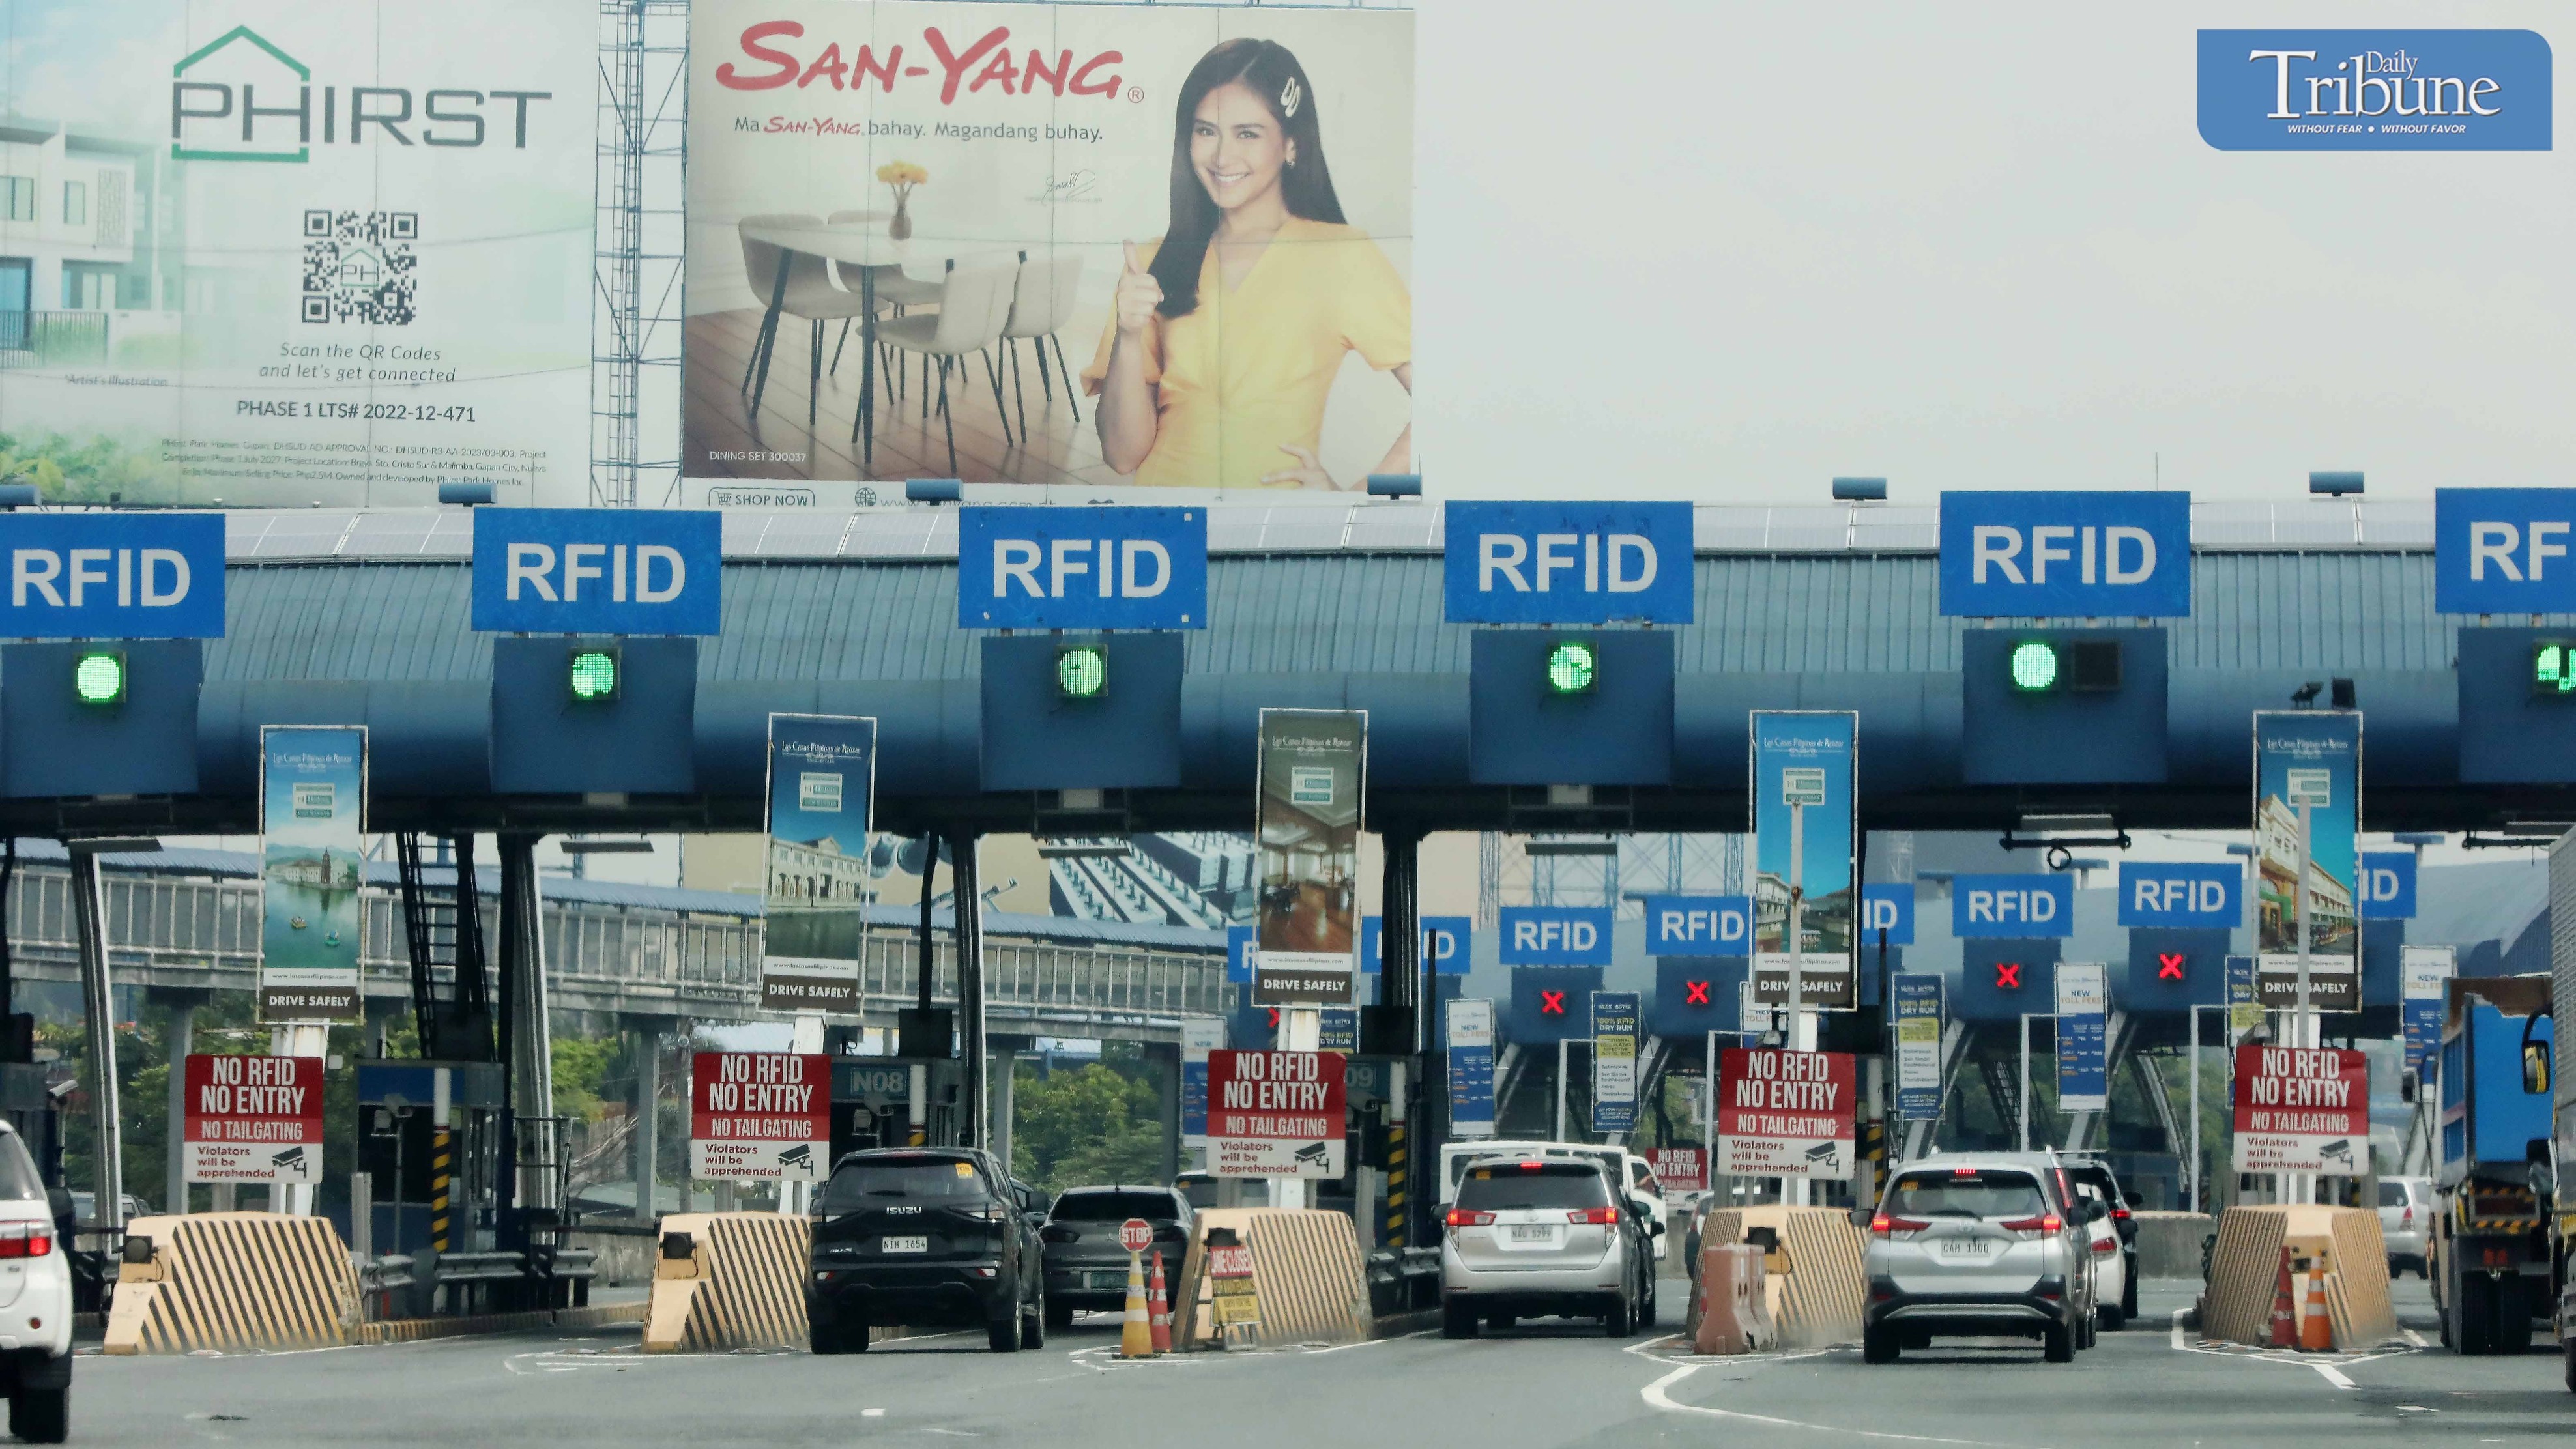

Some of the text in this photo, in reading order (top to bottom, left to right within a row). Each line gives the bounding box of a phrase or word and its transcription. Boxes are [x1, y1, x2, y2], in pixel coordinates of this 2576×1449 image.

[716, 20, 1123, 104] SAN-YANG
[172, 83, 552, 149] PHIRST
[735, 117, 1102, 142] Ma SAN-YANG bahay. Magandang buhay.
[280, 342, 441, 361] Scan the QR Codes
[259, 364, 456, 382] and let's get connected
[237, 400, 476, 422] PHASE 1 LTS# 2022-12-471
[710, 451, 807, 462] DINING SET 300037
[383, 474, 424, 483] developed
[425, 475, 435, 484] by
[736, 494, 808, 506] SHOP NOW
[1972, 525, 2156, 585] RFID
[2470, 521, 2571, 582] RF
[506, 543, 686, 603] RFID
[992, 539, 1171, 598] RFID
[1478, 534, 1658, 593] RFID
[12, 549, 191, 607] RFID
[2134, 880, 2225, 912] RFID
[1863, 900, 1898, 929] ID
[1968, 890, 2056, 923] RFID
[1514, 921, 1597, 951] RFID
[1662, 911, 1744, 941] RFID
[770, 984, 850, 998] DRIVE SAFELY
[1264, 979, 1345, 991] DRIVE SAFELY
[1761, 980, 1843, 992] DRIV SAFELY
[269, 996, 350, 1006] DRIVE SAFELY
[213, 1057, 295, 1085] NO RFID
[721, 1055, 802, 1083] NO RFID
[1236, 1052, 1318, 1081] NO RFID
[1748, 1052, 1829, 1081] NO RFID
[2263, 1049, 2339, 1079] NO RFID
[853, 1070, 904, 1093] N08
[1346, 1067, 1373, 1087] 09
[201, 1085, 305, 1114] NO ENTRY
[710, 1083, 813, 1112] NO ENTRY
[1224, 1081, 1253, 1108] NO
[1260, 1081, 1328, 1110] ENTRY
[1737, 1080, 1838, 1110] NO ENTRY
[2251, 1076, 2351, 1107] NO ENTRY
[202, 1121, 302, 1140] NO TAILGATING
[712, 1118, 811, 1138] NO TAILGATING
[1226, 1116, 1327, 1136] NO TAILGATING
[1737, 1114, 1836, 1136] NO TAILGATING
[2251, 1112, 2349, 1132] NO TAILGATING
[197, 1147, 250, 1155] Violators
[706, 1144, 758, 1154] Violators
[1221, 1142, 1273, 1151] Violators
[1732, 1140, 1784, 1150] Violators
[2248, 1138, 2298, 1147] Violators
[1658, 1149, 1696, 1163] NO RFID
[1731, 1152, 1751, 1160] will
[2247, 1149, 2266, 1158] will
[197, 1169, 274, 1178] apprehended
[705, 1168, 781, 1177] apprehended
[1220, 1165, 1297, 1173] apprehended
[1653, 1163, 1700, 1177] NO ENTRY
[1731, 1163, 1808, 1173] apprehended
[2246, 1160, 2323, 1169] apprehended
[884, 1240, 926, 1249] NIH 1654
[1122, 1227, 1150, 1243] STOP
